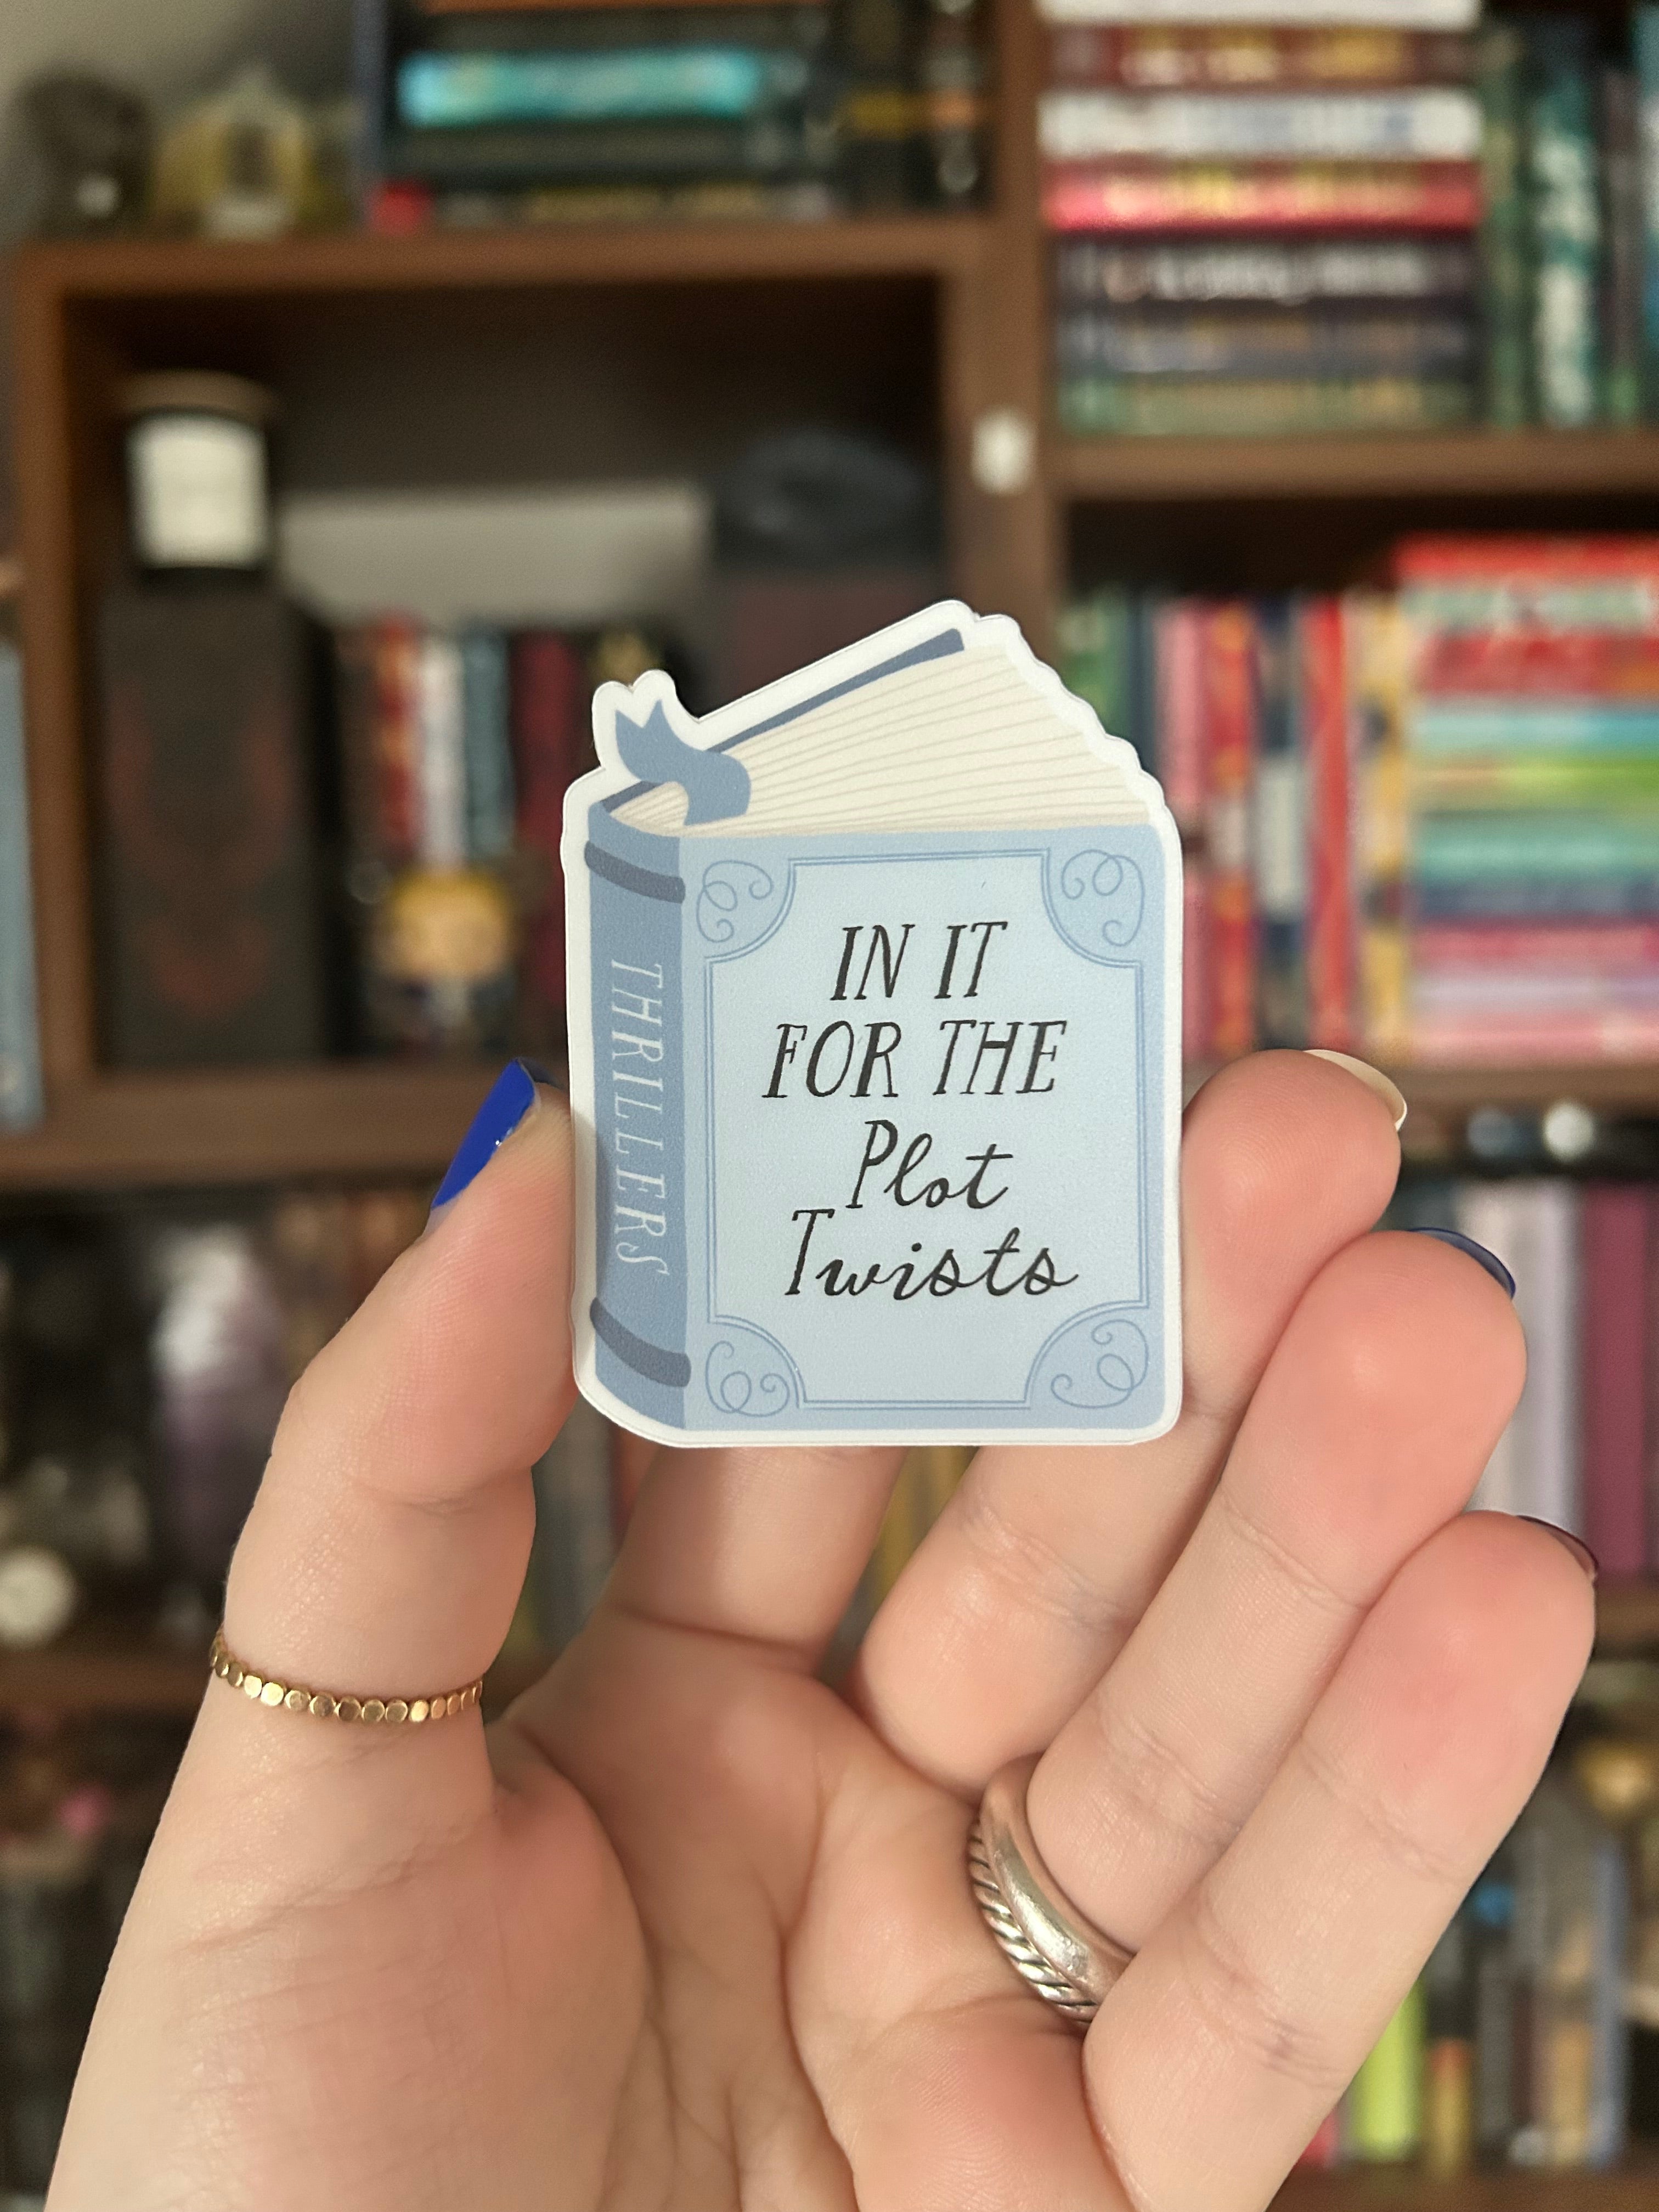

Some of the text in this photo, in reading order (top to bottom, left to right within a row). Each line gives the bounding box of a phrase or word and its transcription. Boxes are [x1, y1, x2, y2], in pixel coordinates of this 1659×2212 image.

[830, 921, 1008, 1001] IN IT
[761, 1019, 1067, 1098] FOR THE
[611, 959, 670, 1276] THRILLERS
[845, 1119, 1014, 1209] Plot
[784, 1207, 1079, 1301] Twists
